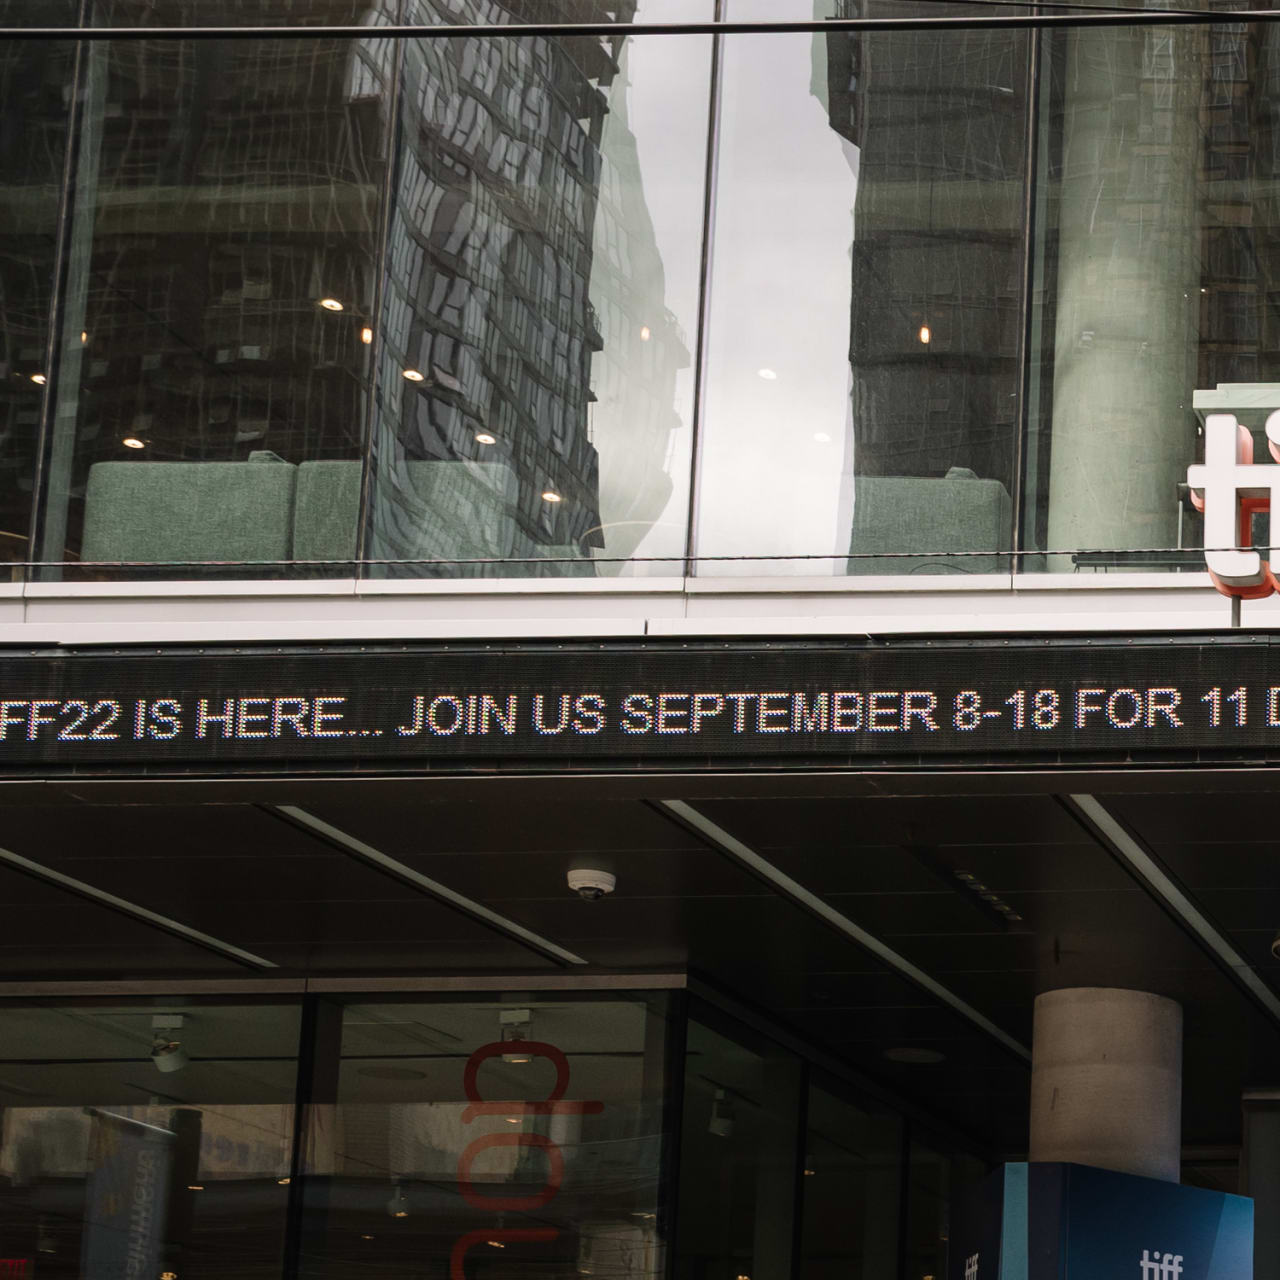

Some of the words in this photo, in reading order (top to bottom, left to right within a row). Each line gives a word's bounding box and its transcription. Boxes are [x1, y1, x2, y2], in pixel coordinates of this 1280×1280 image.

[134, 698, 182, 739] IS
[195, 697, 383, 738] HERE...
[395, 695, 517, 736] JOIN
[532, 694, 606, 734] US
[620, 691, 939, 734] SEPTEMBER
[953, 689, 1060, 730] 8-18
[1075, 687, 1183, 729] FOR
[1201, 686, 1247, 727] 11
